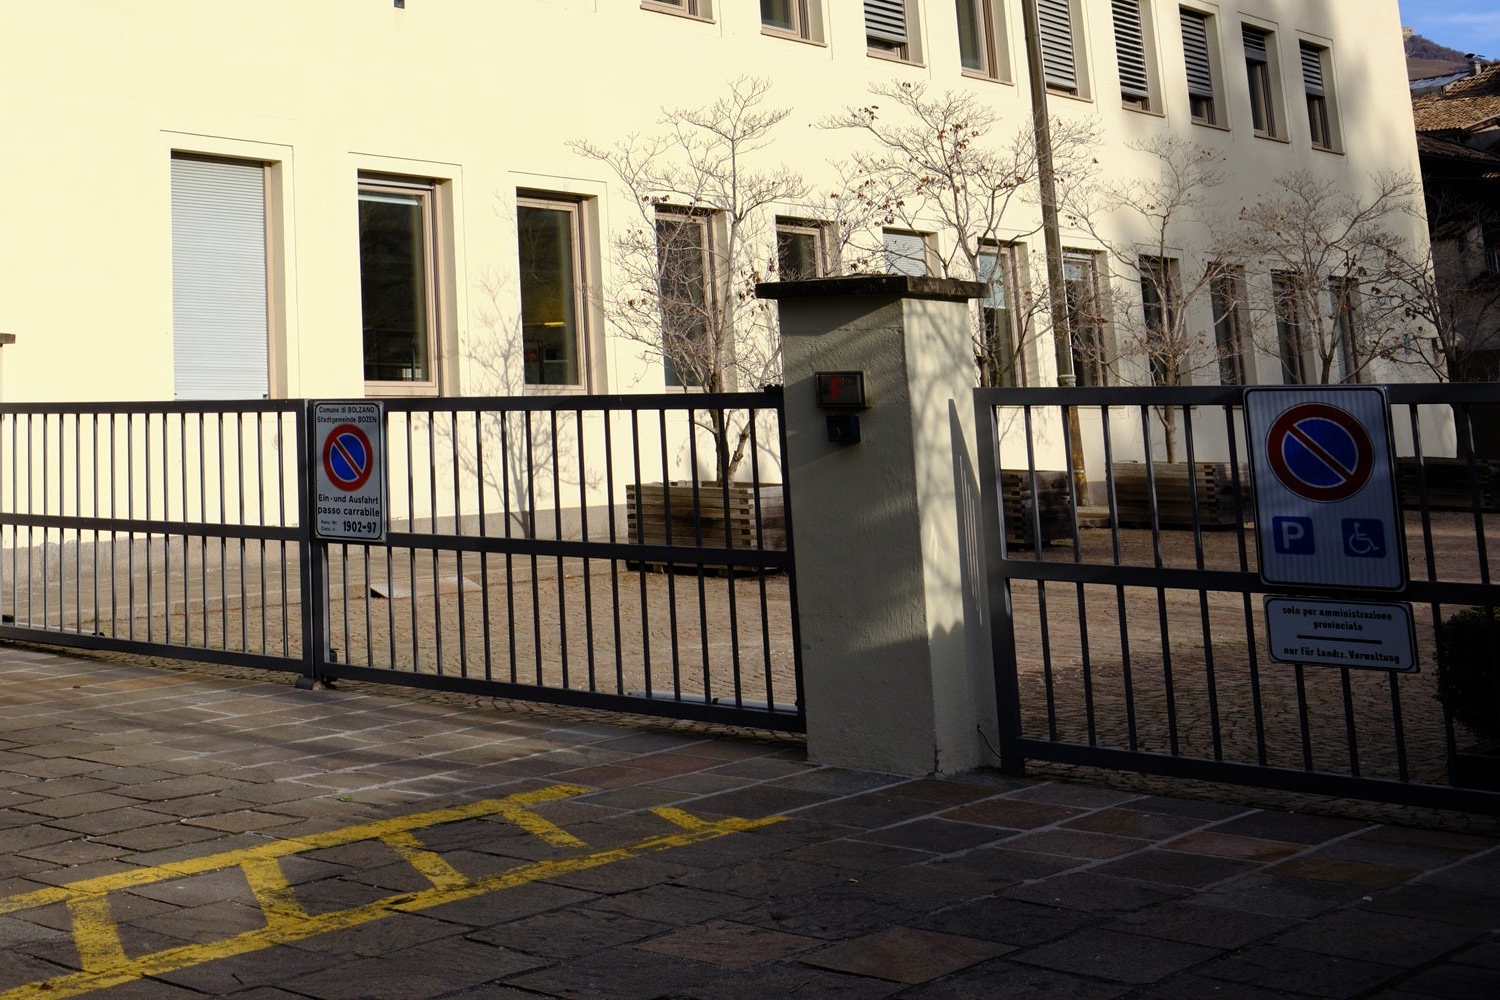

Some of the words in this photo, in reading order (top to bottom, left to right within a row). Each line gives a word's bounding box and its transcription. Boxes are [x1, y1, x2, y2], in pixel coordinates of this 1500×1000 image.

[317, 416, 356, 424] Stadtgemeinde
[349, 496, 379, 505] Ausfahrt
[318, 507, 341, 515] passo
[344, 507, 380, 517] carrabile
[343, 520, 377, 534] 1902-97
[1282, 521, 1304, 550] P
[1282, 606, 1300, 615] solo
[1303, 608, 1317, 617] per
[1319, 609, 1392, 621] amministrazione
[1313, 621, 1363, 632] provinciale
[1284, 647, 1298, 655] nur
[1300, 647, 1314, 656] für
[1348, 650, 1400, 664] Verwaltung
